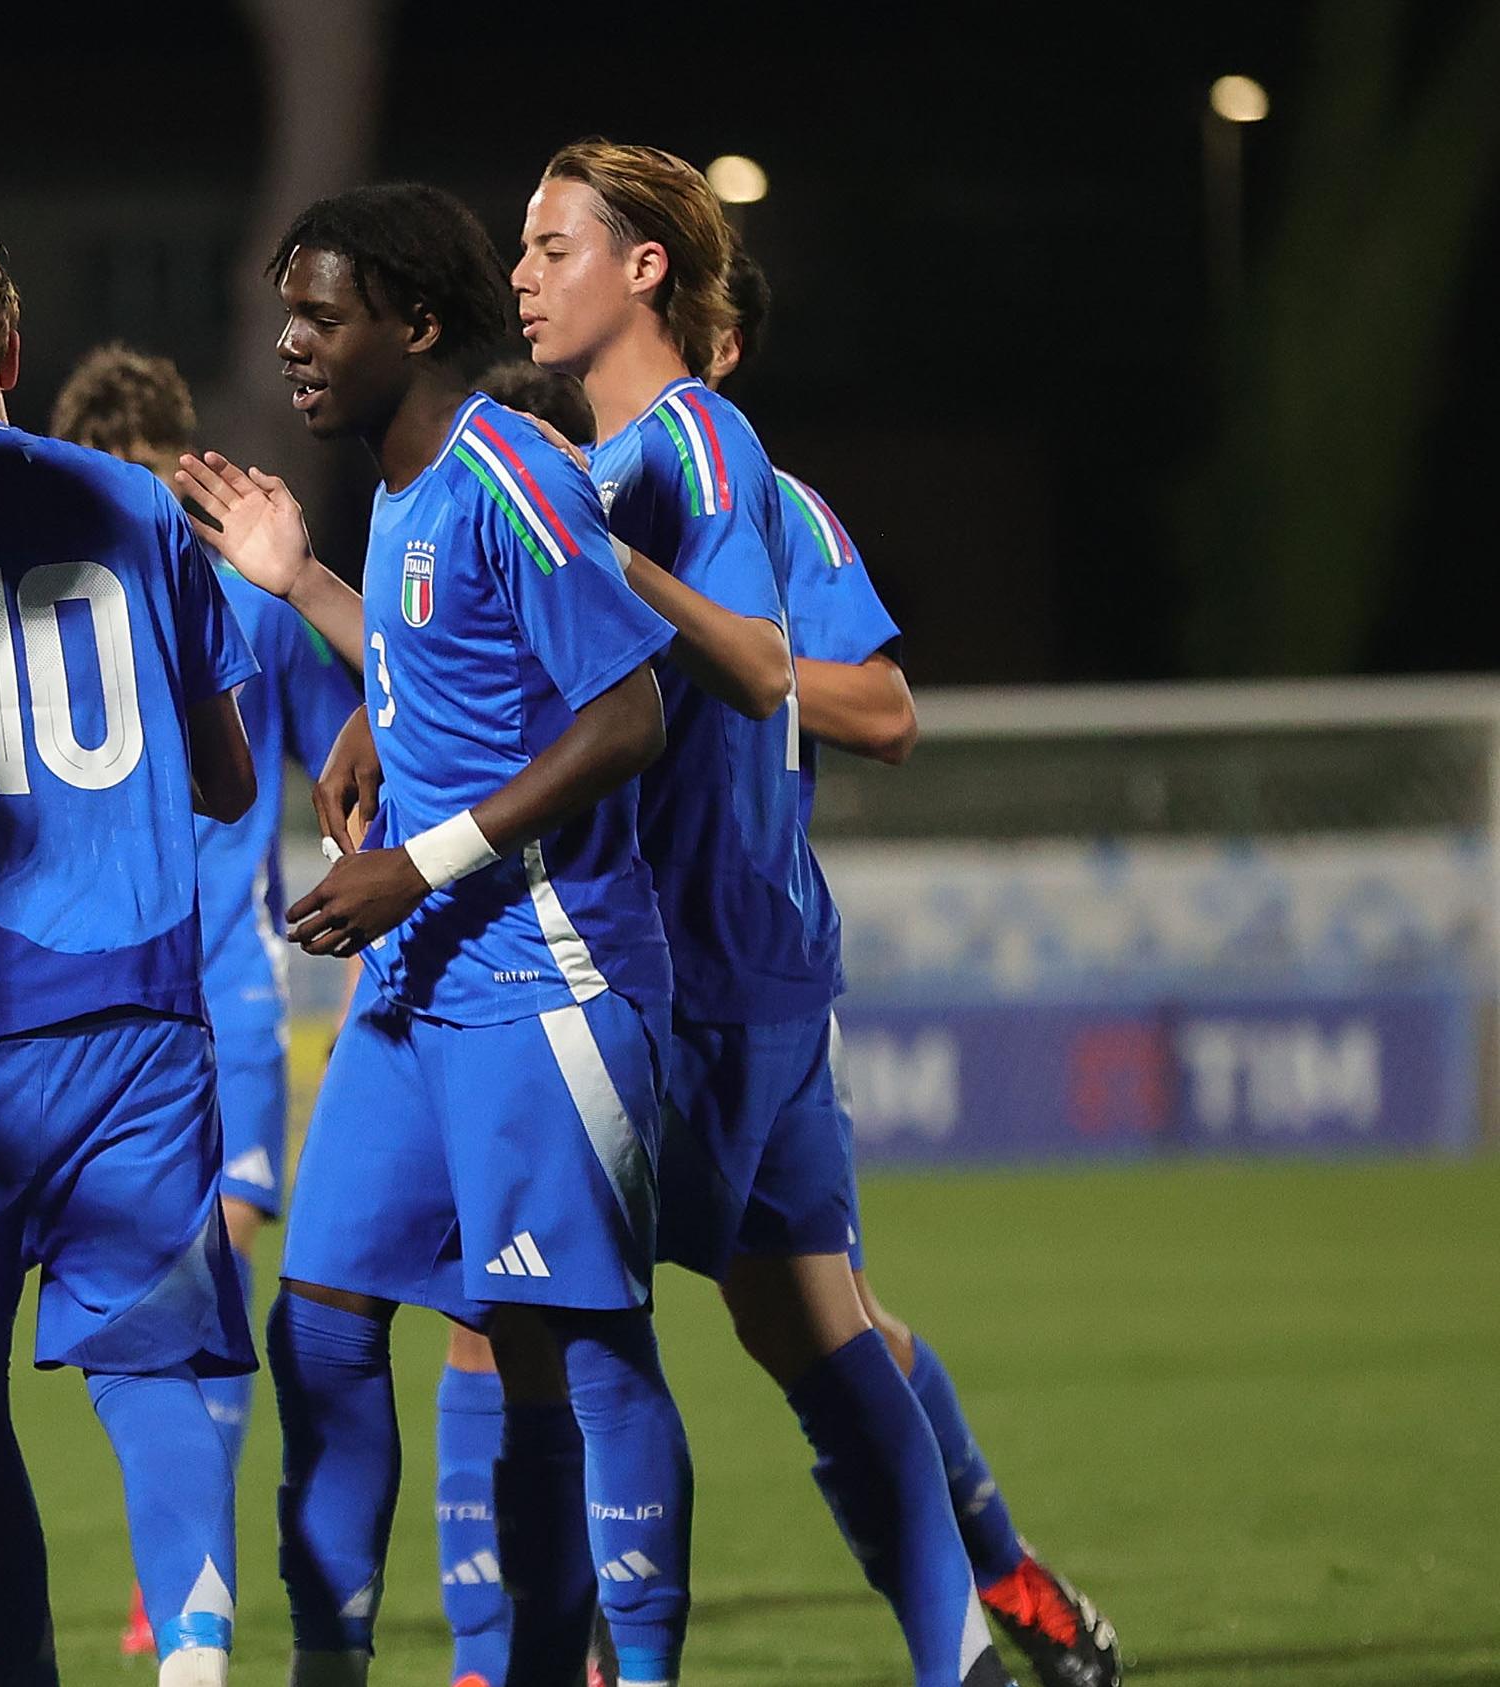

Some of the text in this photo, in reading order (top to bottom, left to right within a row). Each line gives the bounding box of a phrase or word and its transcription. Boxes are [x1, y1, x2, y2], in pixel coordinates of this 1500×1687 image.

[406, 558, 431, 574] ITALIA
[370, 631, 396, 728] 3
[591, 1503, 664, 1521] ITALIA
